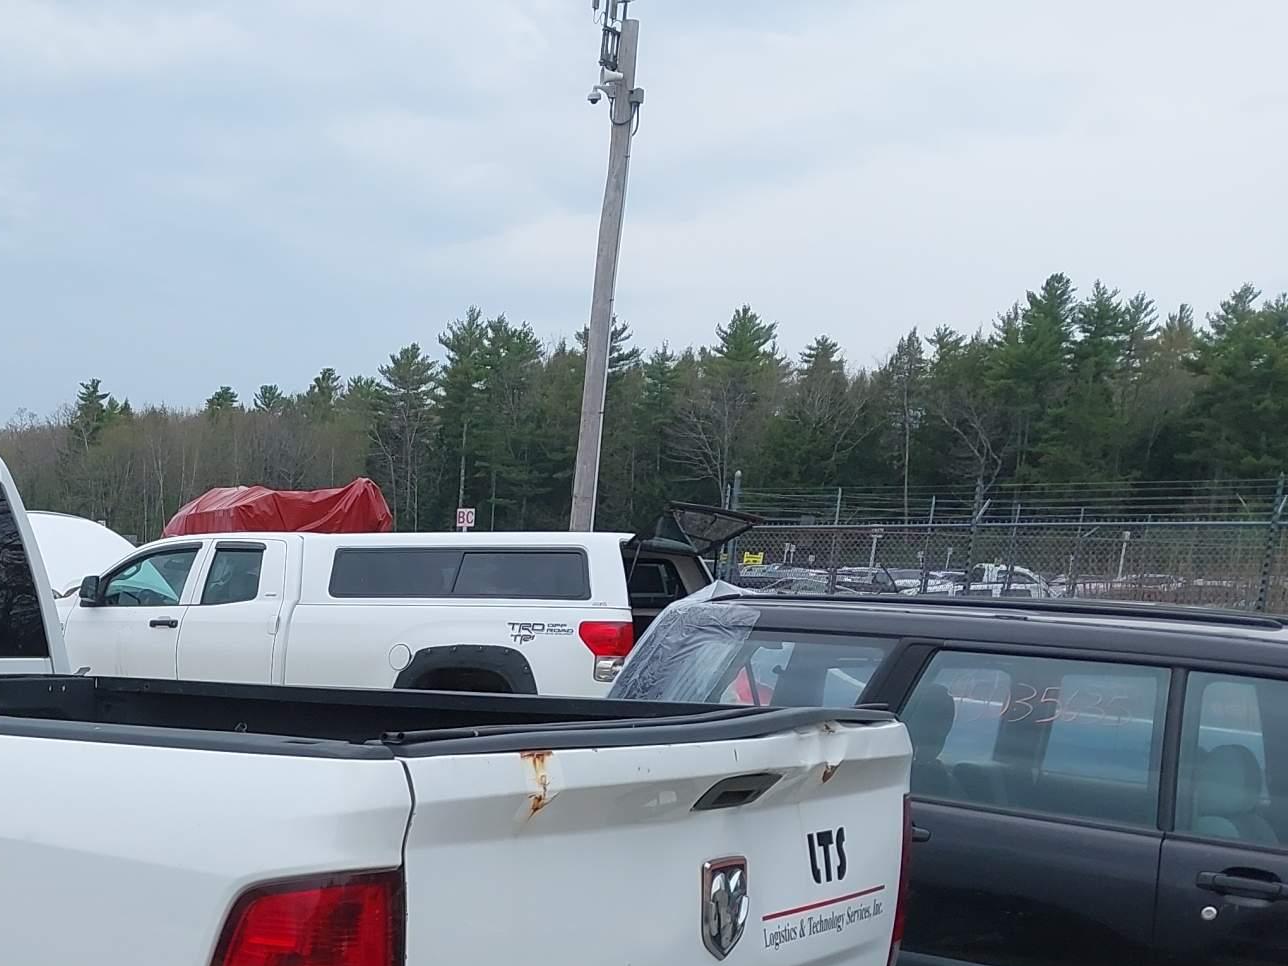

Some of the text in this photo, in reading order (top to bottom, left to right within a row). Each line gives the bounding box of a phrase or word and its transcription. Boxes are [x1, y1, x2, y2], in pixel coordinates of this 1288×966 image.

[458, 510, 474, 524] BC
[507, 622, 546, 634] TRD
[807, 826, 847, 884] LTS
[763, 922, 798, 950] Logistics
[799, 918, 806, 938] &
[807, 911, 845, 936] Technology
[873, 898, 884, 917] Inc.
